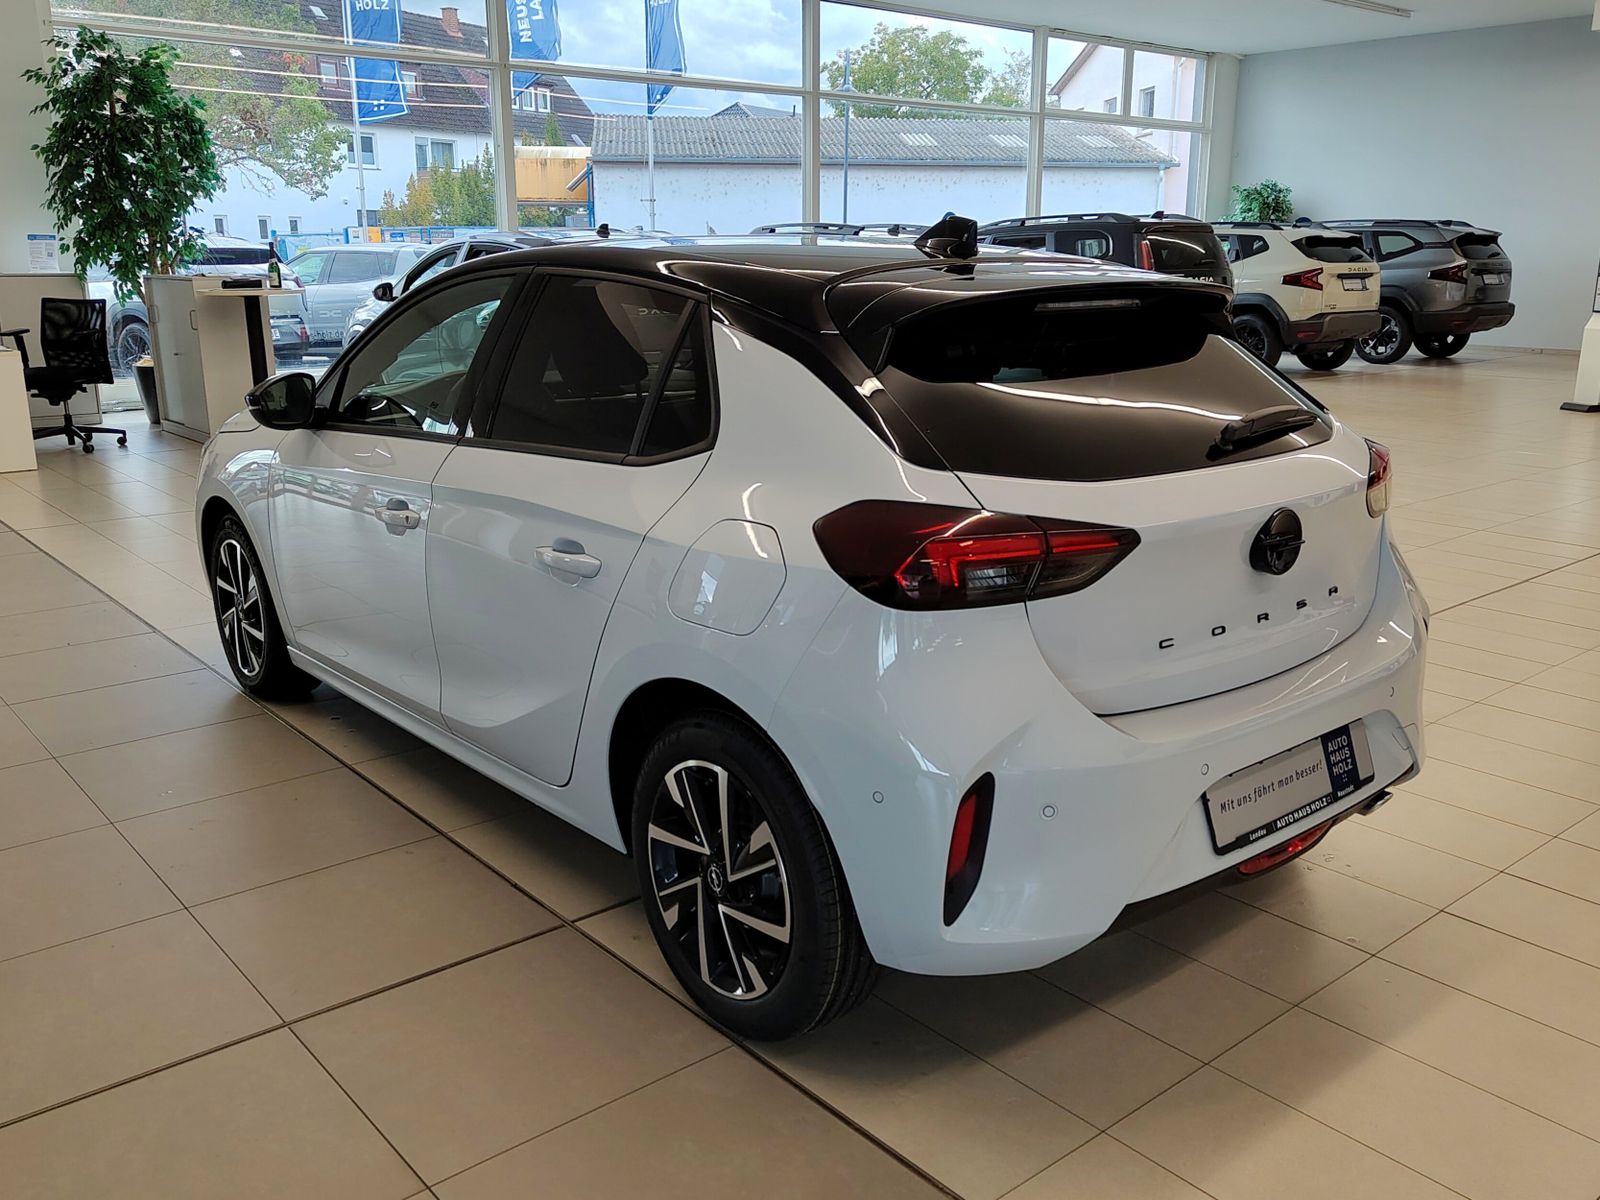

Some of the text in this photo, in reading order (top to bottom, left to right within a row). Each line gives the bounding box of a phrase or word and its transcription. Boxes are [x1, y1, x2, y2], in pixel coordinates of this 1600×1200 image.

[355, 0, 389, 11] HOLZ
[1158, 585, 1339, 650] CORSA
[1328, 735, 1348, 753] AUTO
[1330, 747, 1350, 765] HAUS
[1332, 759, 1353, 777] HOLZ
[1220, 759, 1323, 814] Mit uns fährt man besser!
[1276, 813, 1294, 829] AUTO
[1293, 806, 1311, 822] HAUS
[1311, 798, 1327, 813] HOLZ
